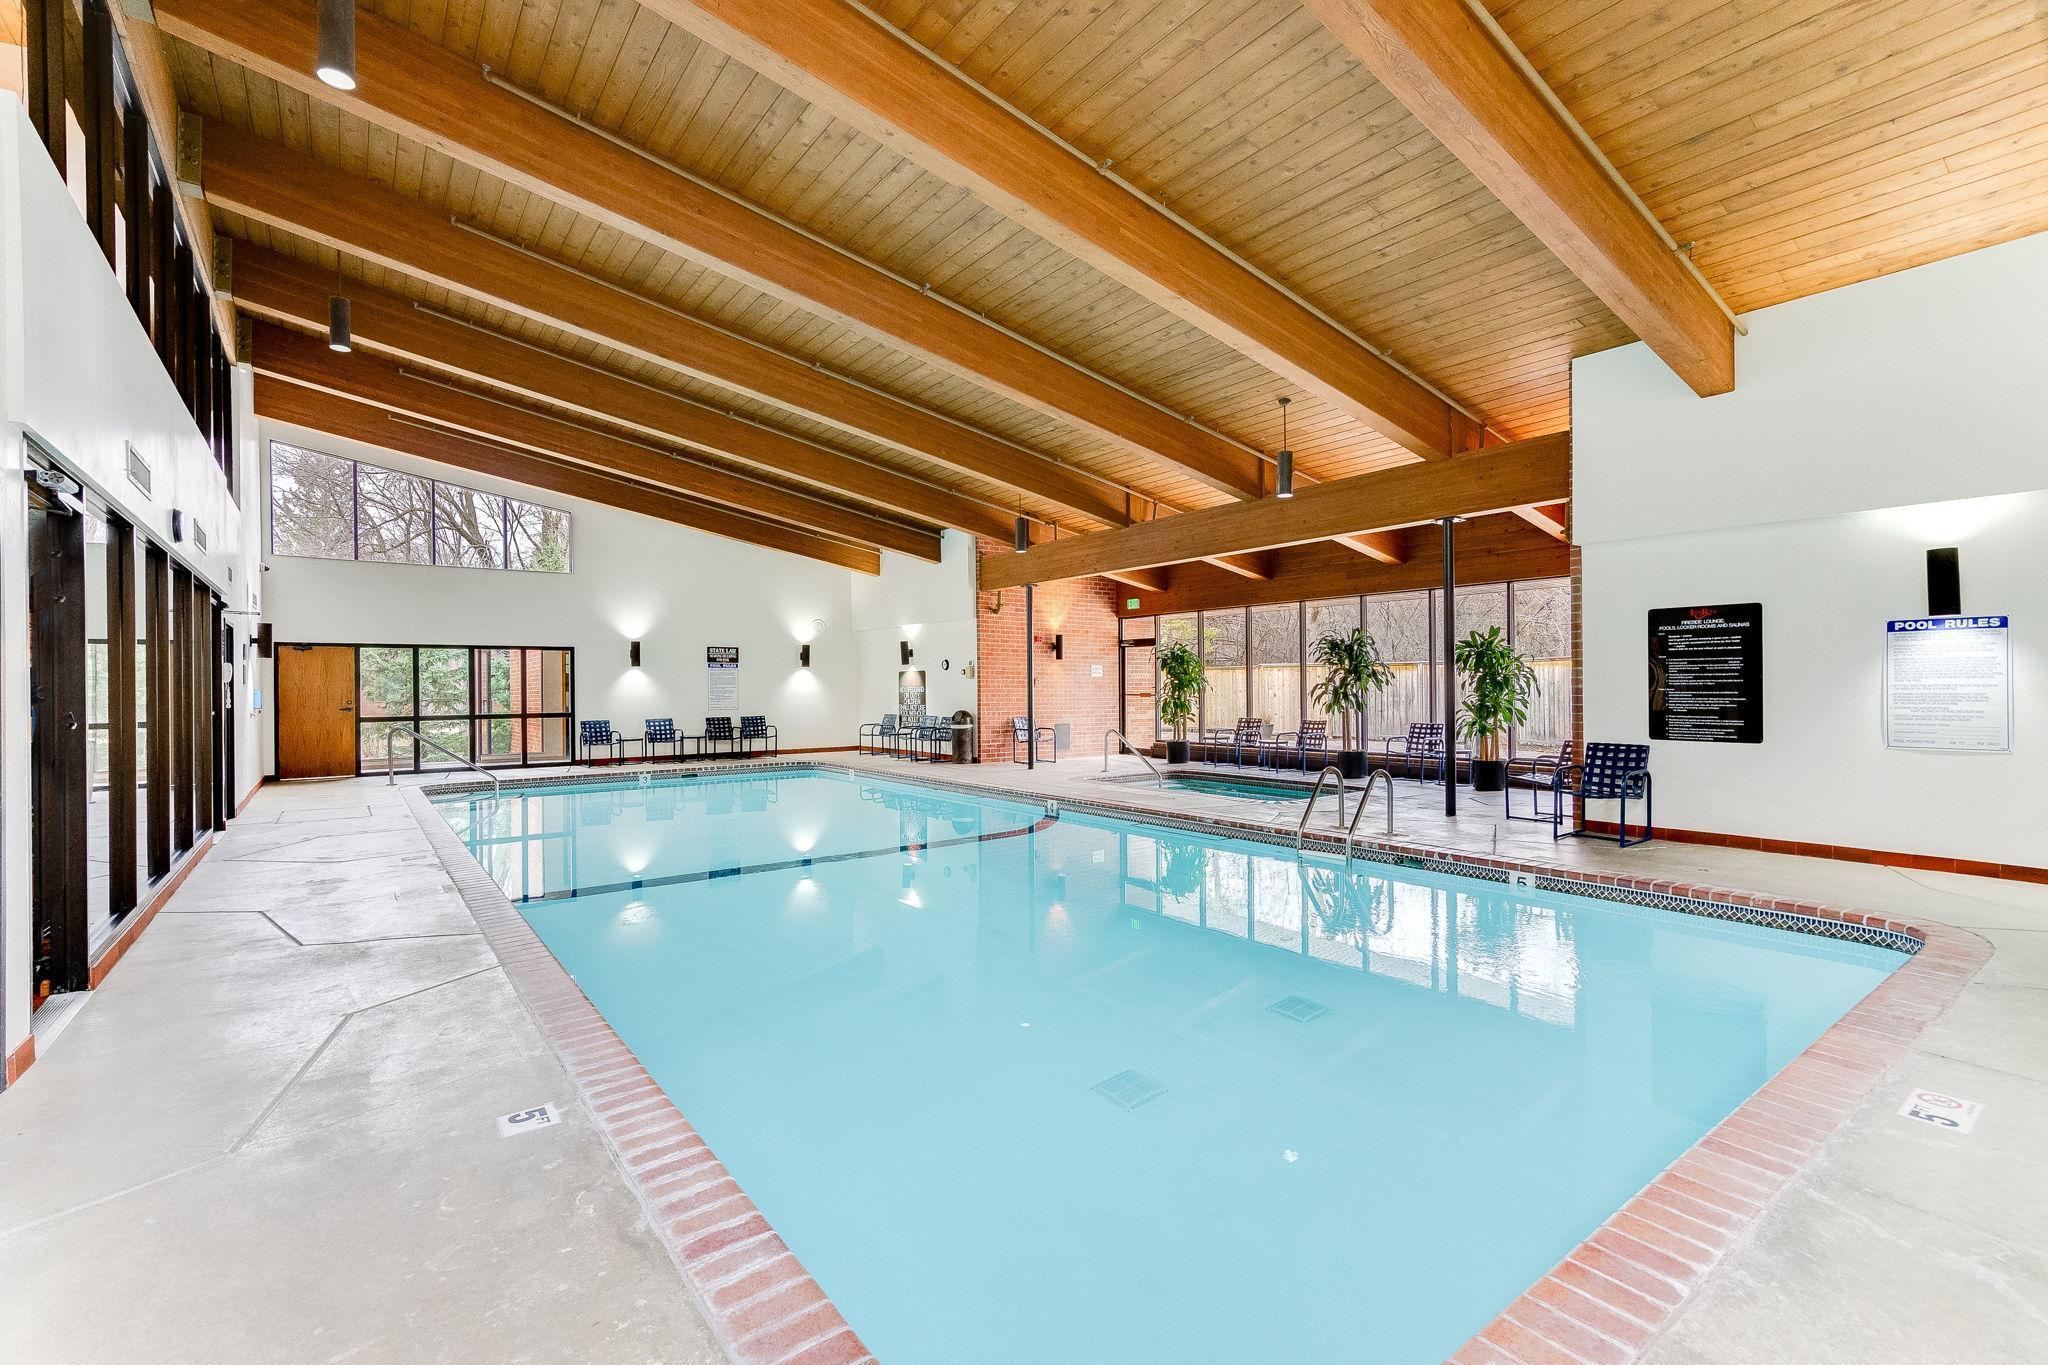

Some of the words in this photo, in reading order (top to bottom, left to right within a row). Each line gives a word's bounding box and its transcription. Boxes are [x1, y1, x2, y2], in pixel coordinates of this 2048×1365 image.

[1895, 621, 1936, 630] POOL
[1944, 618, 2000, 628] RULES
[507, 1107, 549, 1124] 5
[1905, 1109, 1960, 1128] 5
